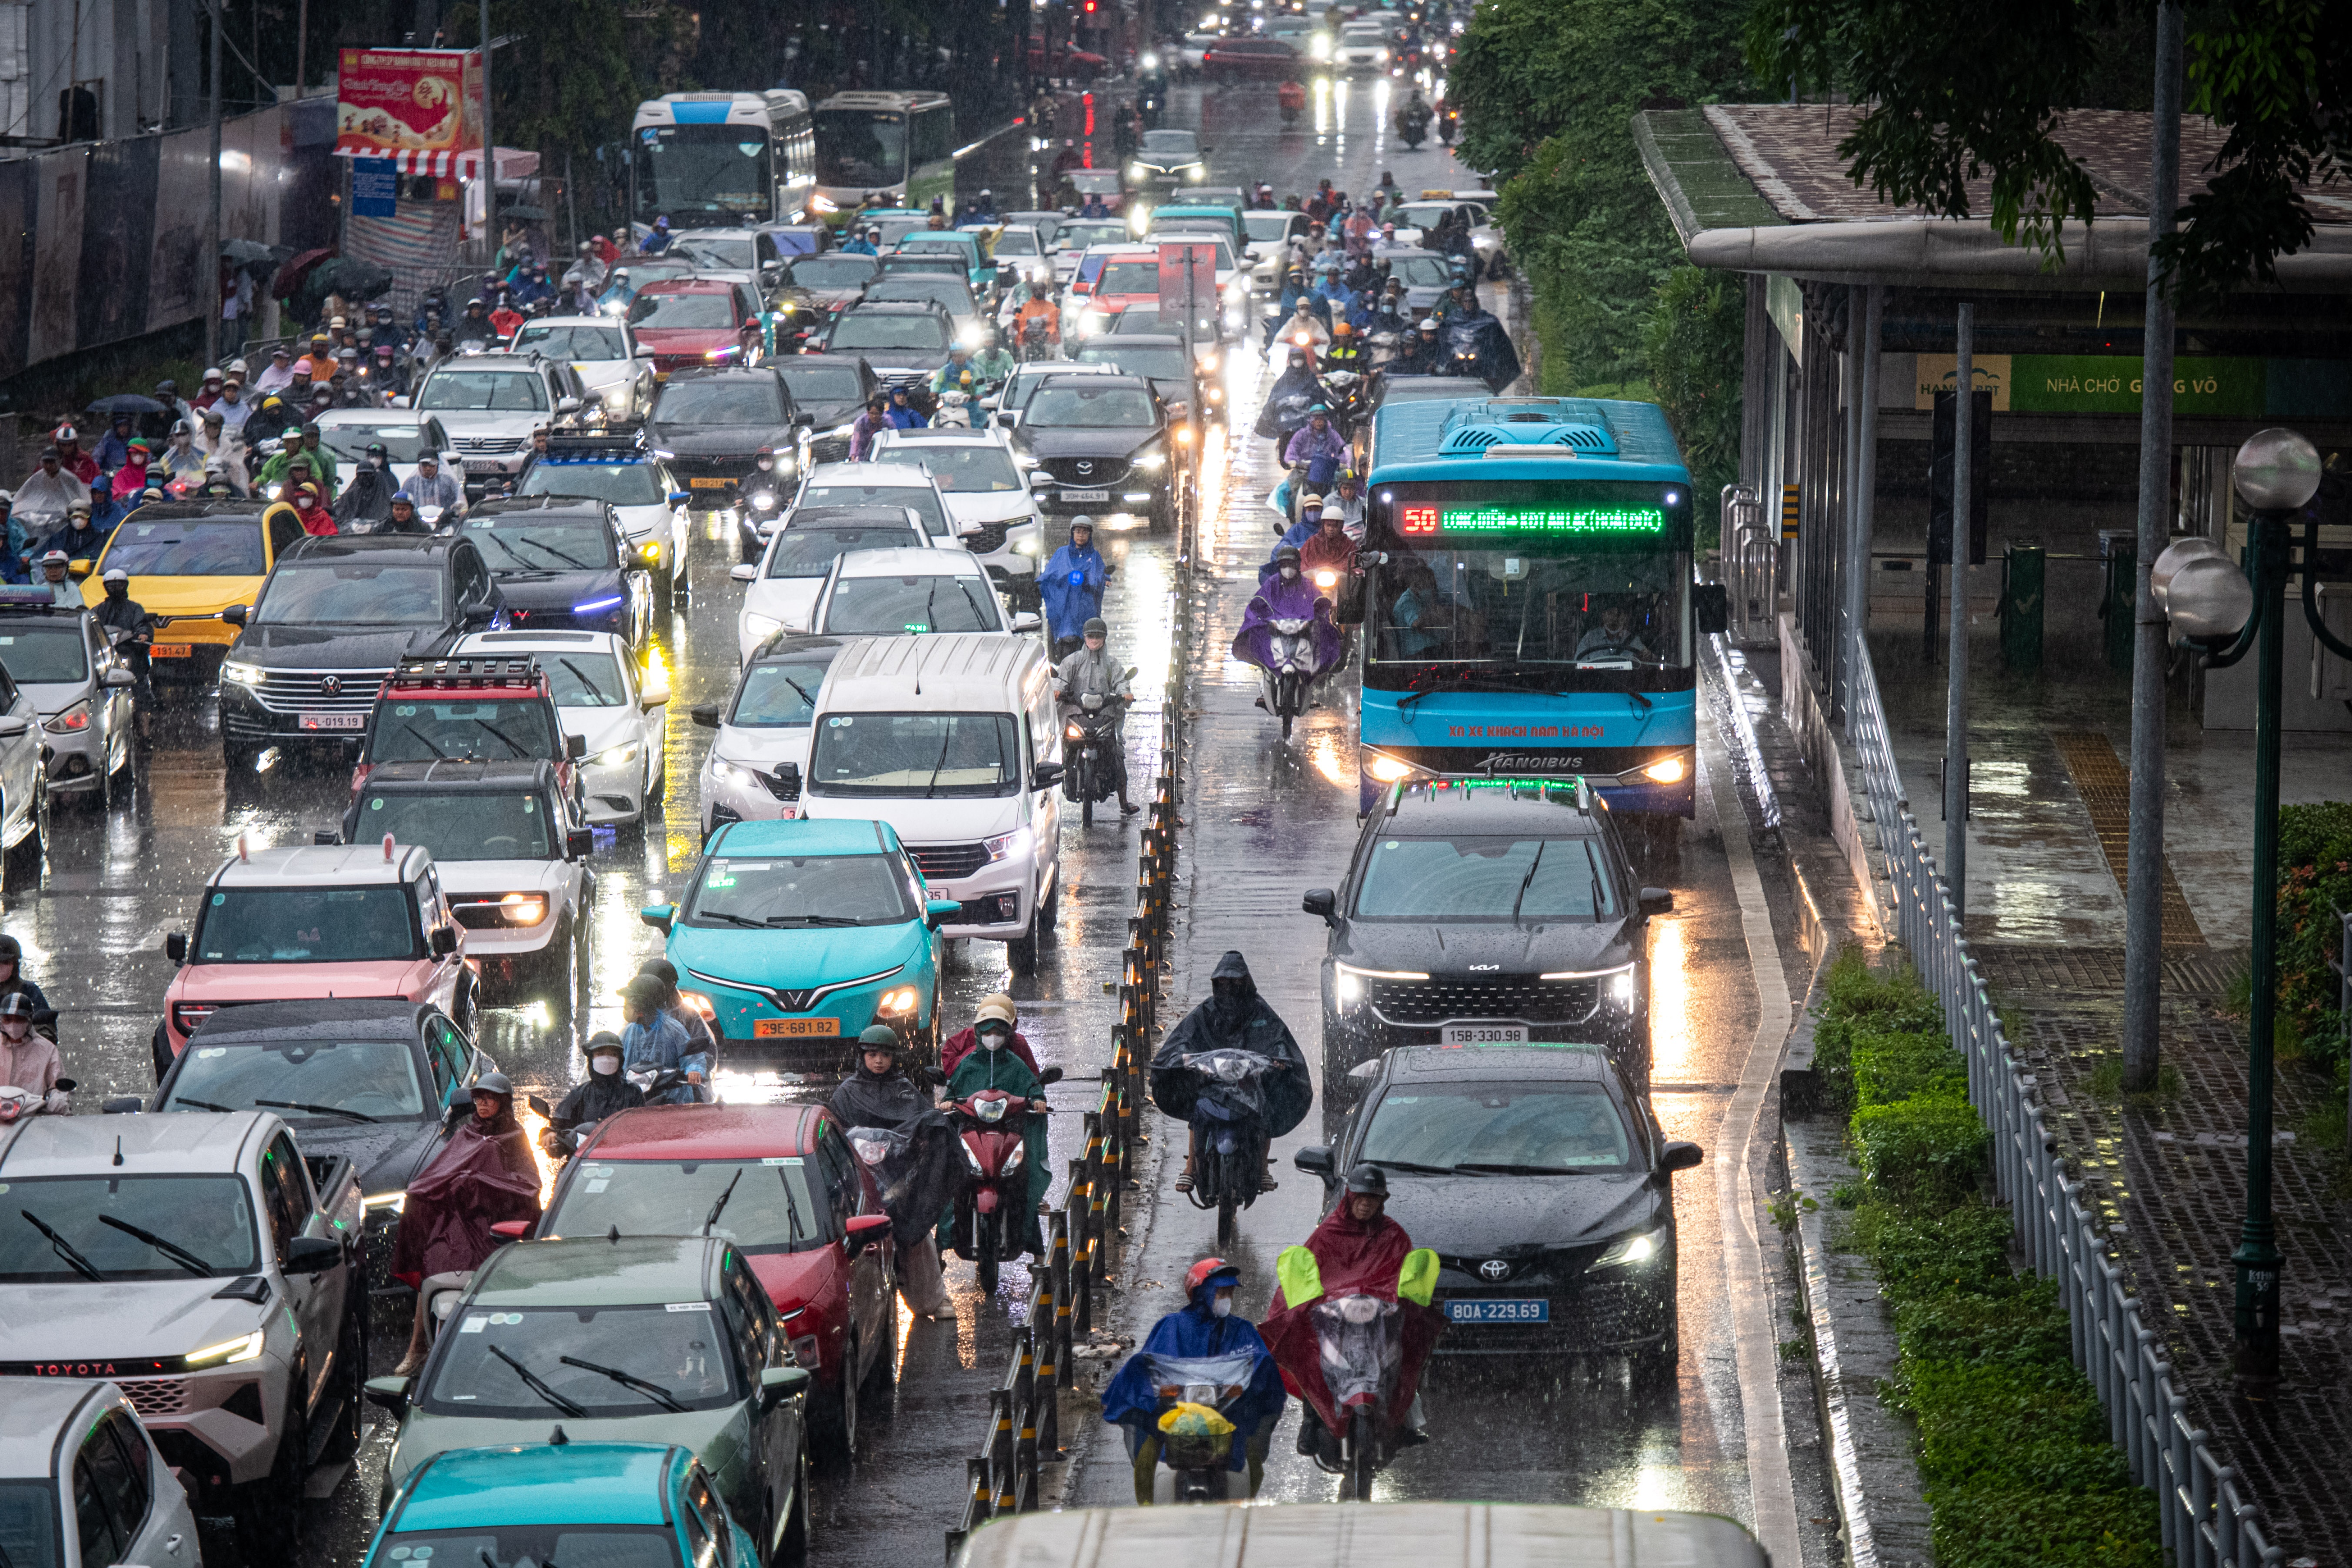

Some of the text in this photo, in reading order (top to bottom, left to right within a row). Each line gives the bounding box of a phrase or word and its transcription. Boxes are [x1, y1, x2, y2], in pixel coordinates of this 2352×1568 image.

[2047, 376, 2079, 392] NHÀ
[2085, 375, 2120, 393] CHỜ
[2192, 376, 2217, 394] VÕ
[1405, 509, 1436, 531] 50
[1469, 726, 1483, 737] XE
[1487, 724, 1527, 737] KHÁCH
[1531, 726, 1558, 737] NAM
[1562, 724, 1579, 737] HÀ
[1582, 724, 1604, 739] NỘI
[1475, 752, 1583, 768] HANOIBUS
[708, 878, 735, 888] TAXI
[762, 1022, 832, 1035] 29E-681.82
[1451, 1030, 1521, 1041] 15B-330.98
[1454, 1304, 1540, 1318] 80A-229.69
[35, 1364, 116, 1375] TOYOTA
